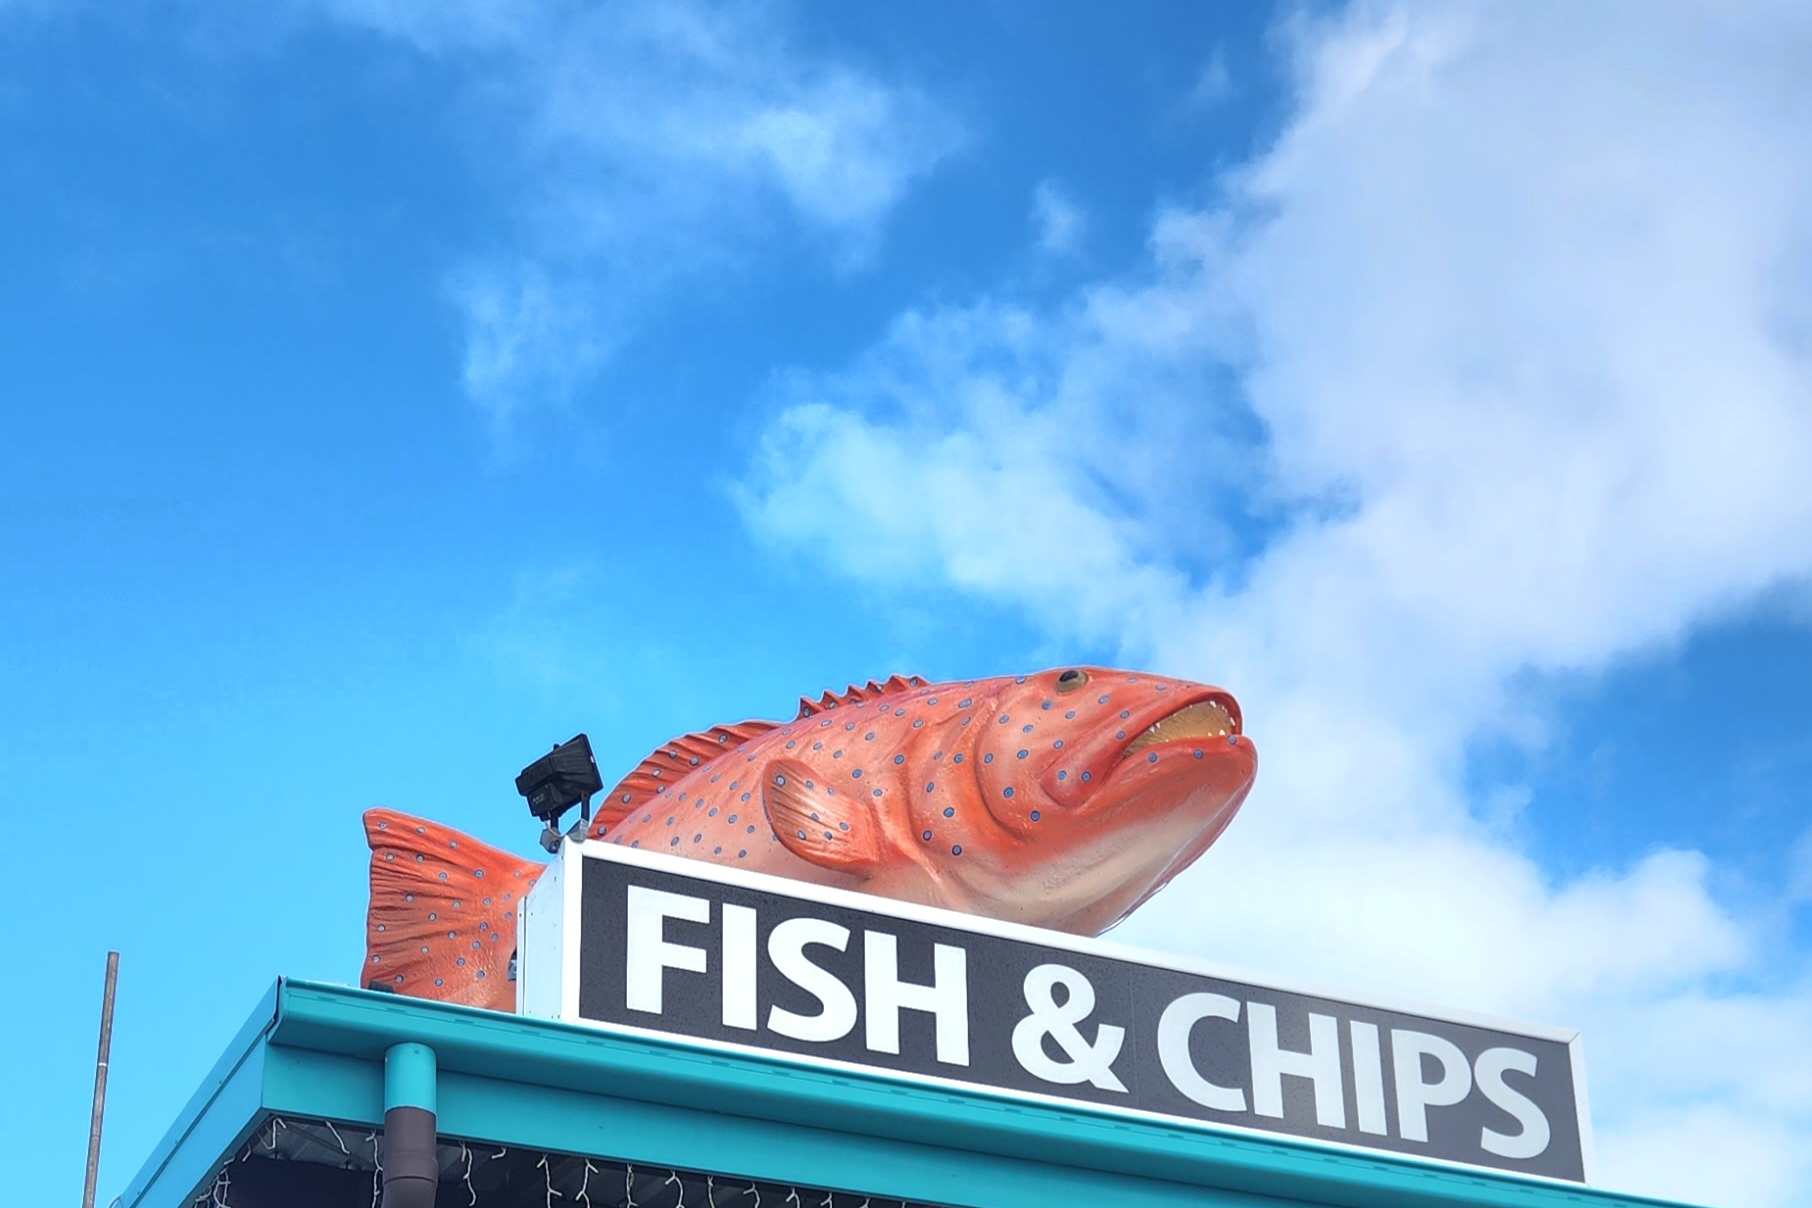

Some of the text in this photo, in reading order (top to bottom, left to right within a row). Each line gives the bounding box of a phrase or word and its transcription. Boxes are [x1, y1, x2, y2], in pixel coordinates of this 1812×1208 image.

[625, 884, 1552, 1160] FISH & CHIPS
